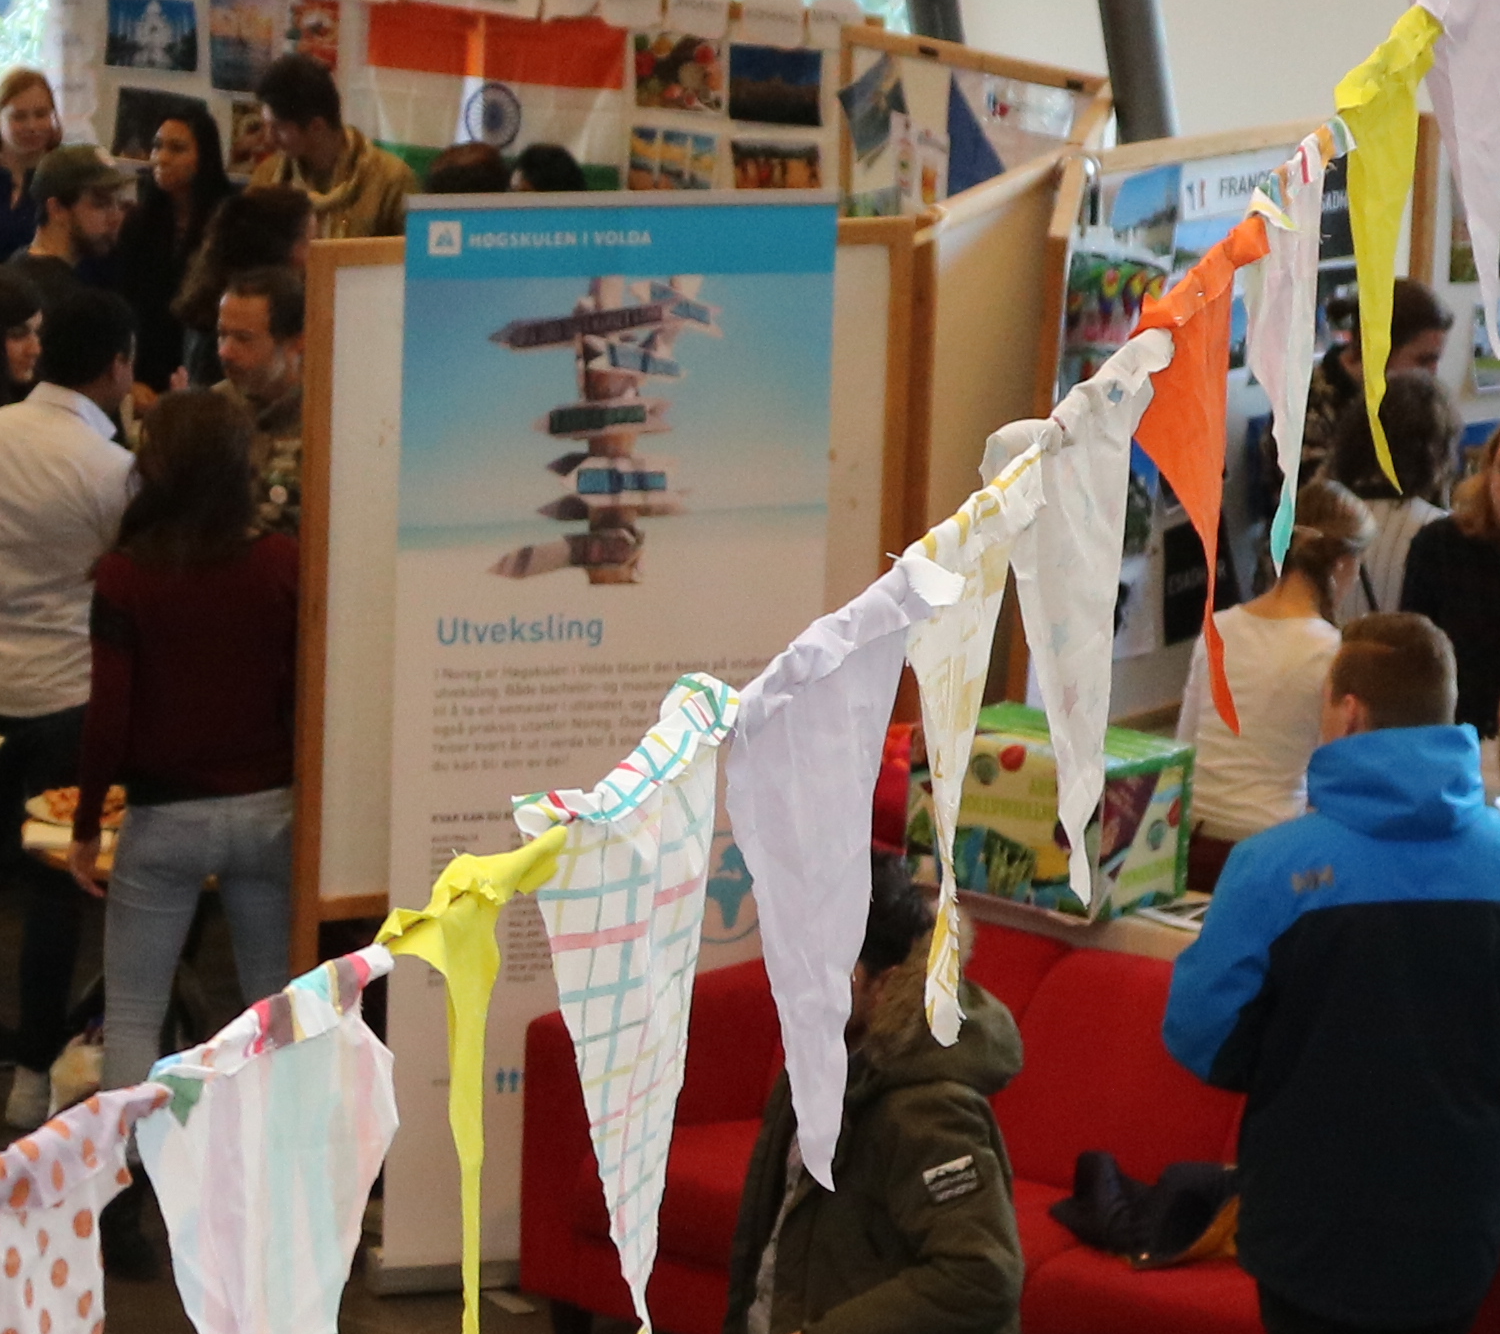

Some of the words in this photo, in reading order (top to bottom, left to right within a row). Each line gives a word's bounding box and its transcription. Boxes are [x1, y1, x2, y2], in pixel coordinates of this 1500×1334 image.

[1219, 169, 1272, 199] FRANC
[469, 231, 577, 247] HØGSKULEN
[594, 229, 652, 245] VOLDA
[437, 615, 604, 646] Utveksling
